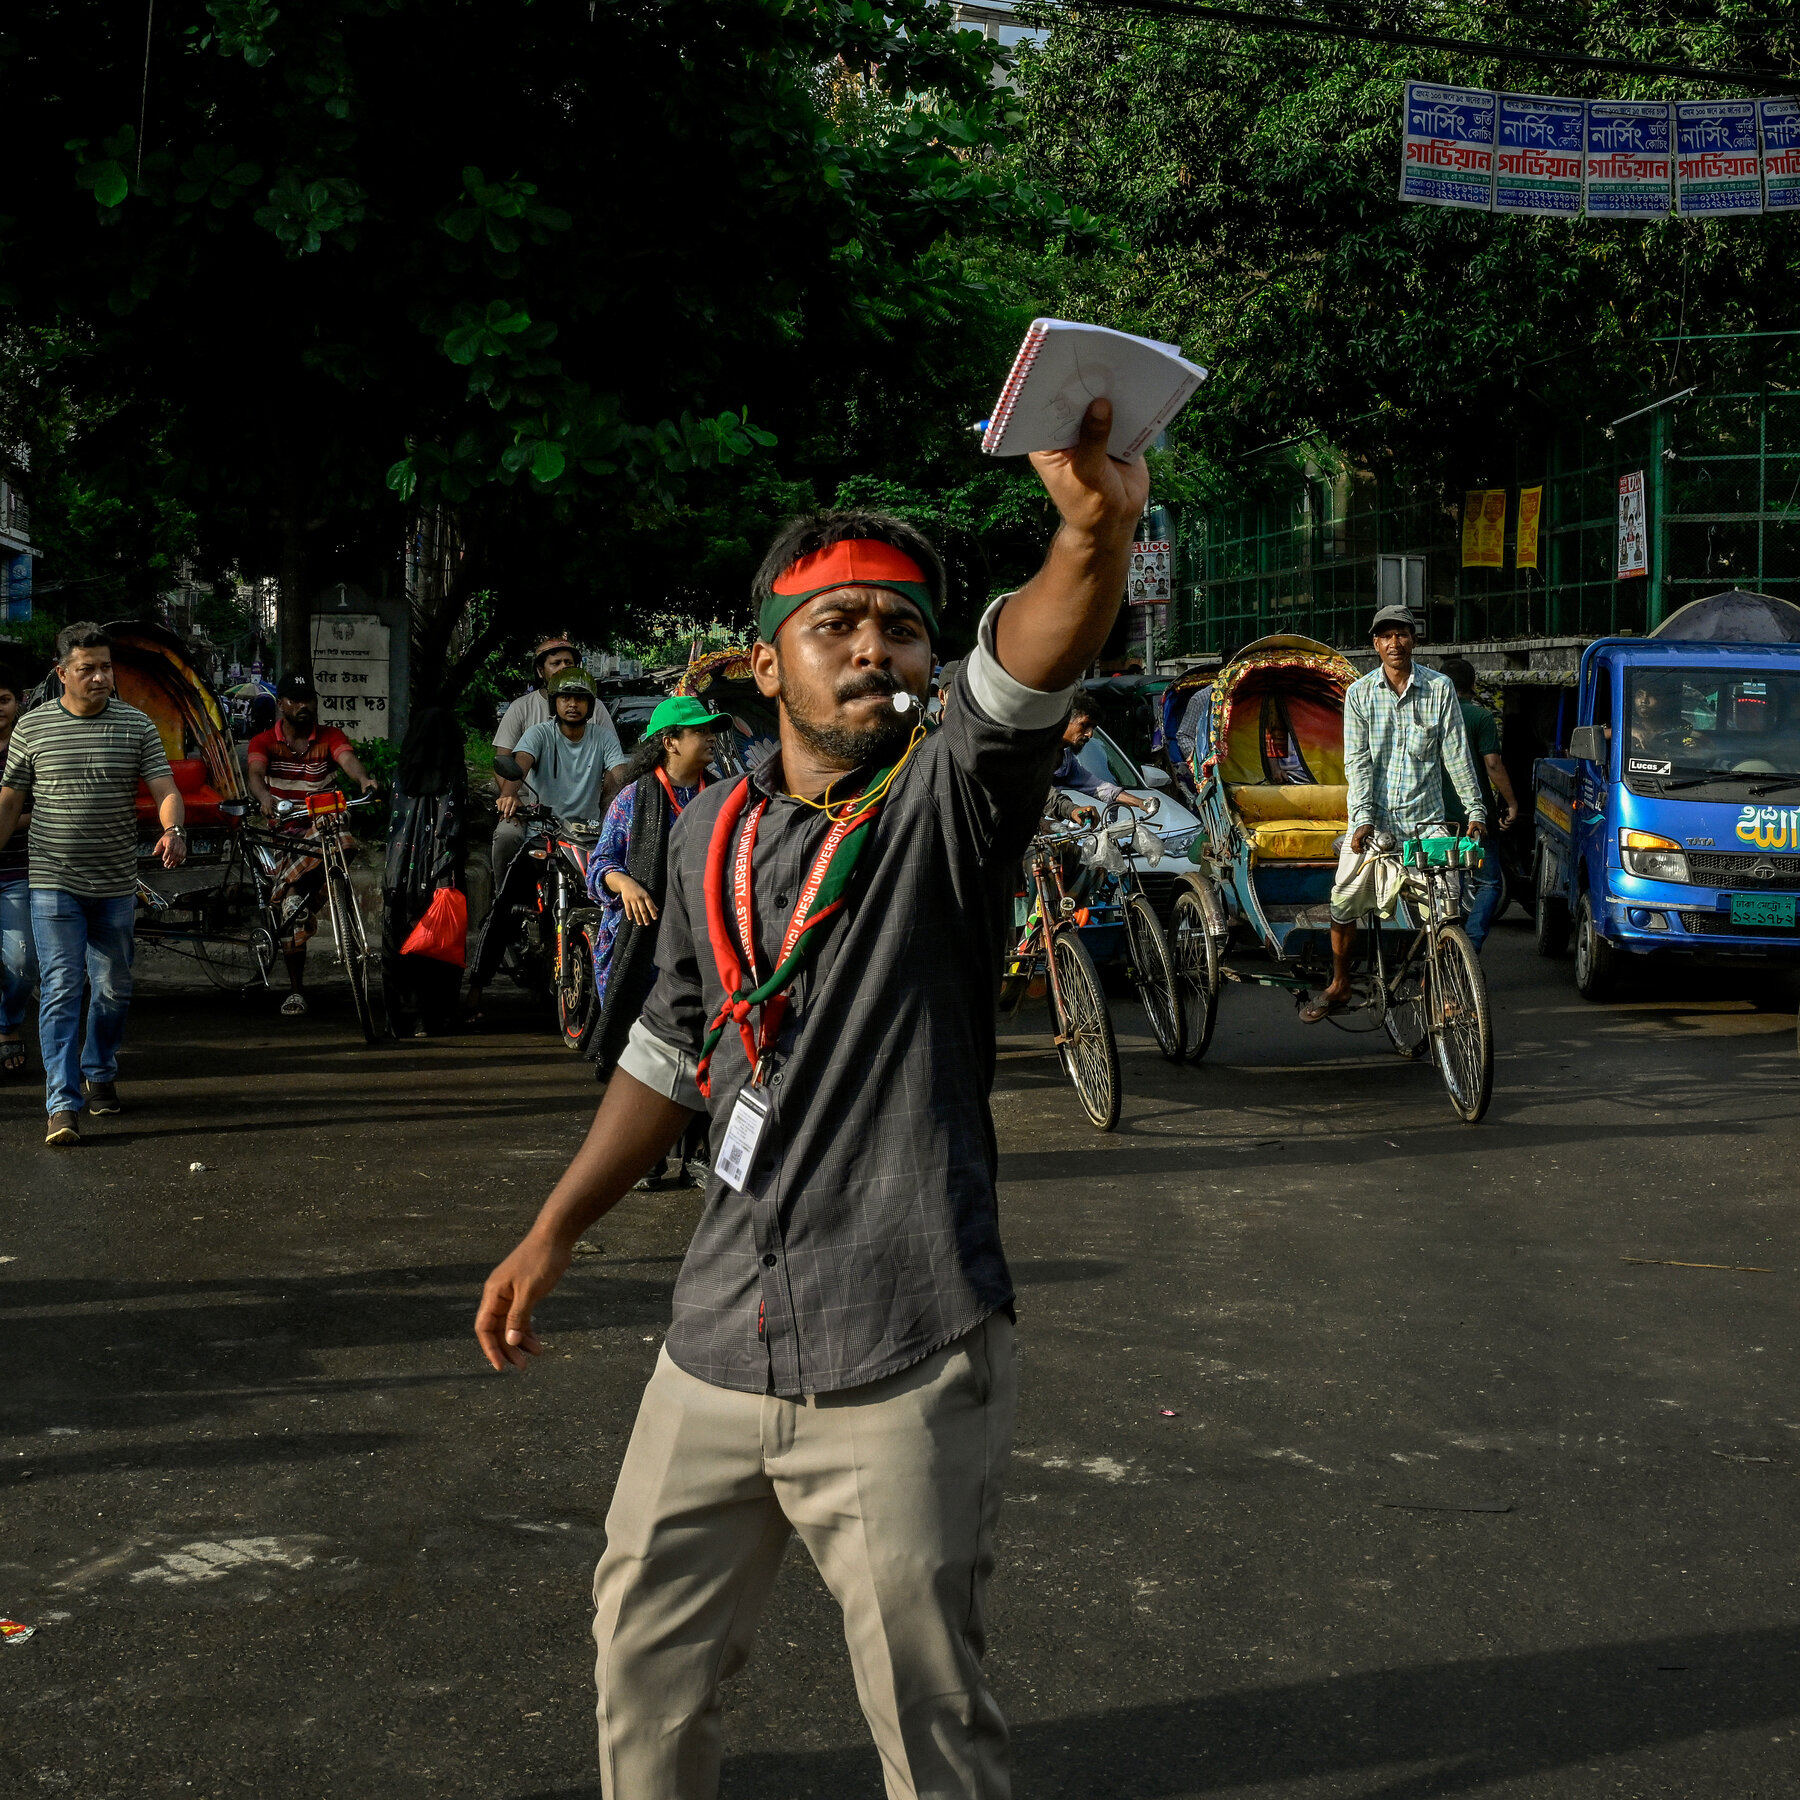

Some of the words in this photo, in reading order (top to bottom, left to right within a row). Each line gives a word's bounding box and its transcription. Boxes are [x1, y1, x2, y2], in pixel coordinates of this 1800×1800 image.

[1409, 104, 1467, 139] নার্সিং
[1501, 114, 1557, 146] নার্সিং
[1589, 119, 1645, 151] নার্সিং
[1678, 118, 1733, 150] নার্সিং
[1406, 138, 1492, 171] গার্ডিয়ান
[1498, 148, 1582, 180] গার্ডিয়ান
[1588, 153, 1669, 182] গার্ডিয়ান
[1678, 152, 1758, 179] গার্ডিয়ান
[1140, 542, 1170, 552] UCC
[315, 671, 338, 683] বীর
[341, 671, 368, 683] উত্তম
[322, 695, 359, 711] আর
[363, 695, 387, 711] দত্ত
[1631, 760, 1658, 771] Lucas
[811, 819, 848, 884] UNIVERSITY
[1685, 837, 1715, 847] TATA
[734, 834, 753, 897] UNIVERSITY
[1733, 911, 1794, 925] ১২-১৭৮২
[1736, 900, 1755, 908] ঢাকা
[736, 906, 753, 960] STUDENT
